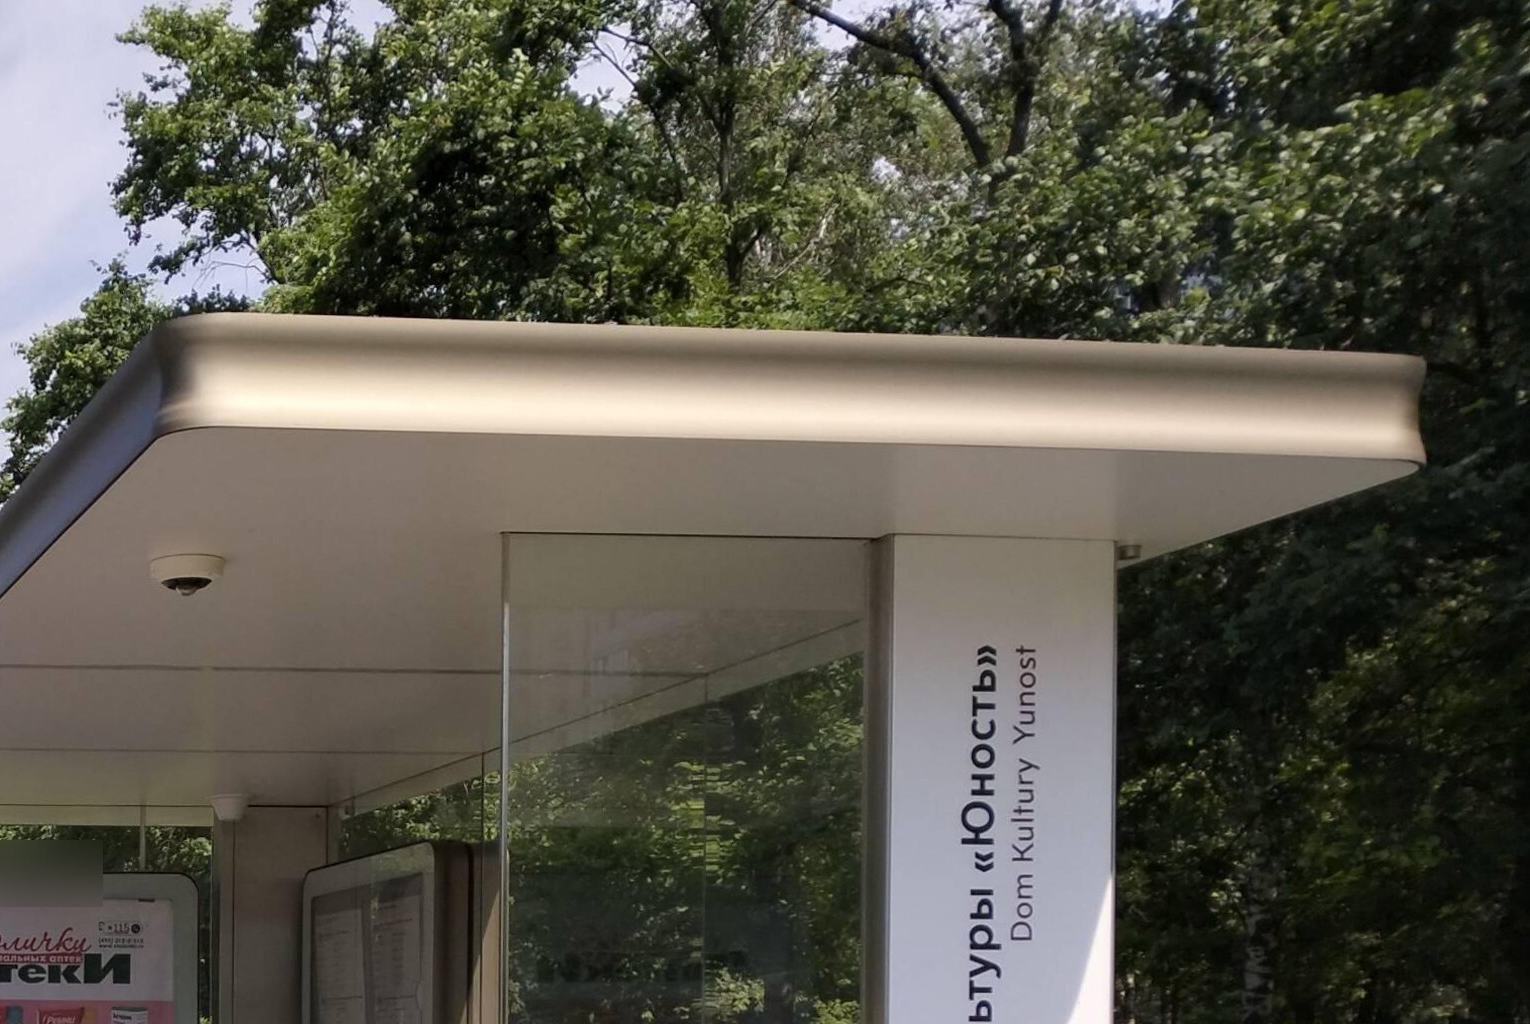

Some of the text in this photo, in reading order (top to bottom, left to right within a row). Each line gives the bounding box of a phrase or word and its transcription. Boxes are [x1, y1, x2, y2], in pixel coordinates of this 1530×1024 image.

[960, 643, 997, 874] «Юность»
[1010, 644, 1041, 942] Dom Kultury Yunost
[49, 954, 82, 964] аптек
